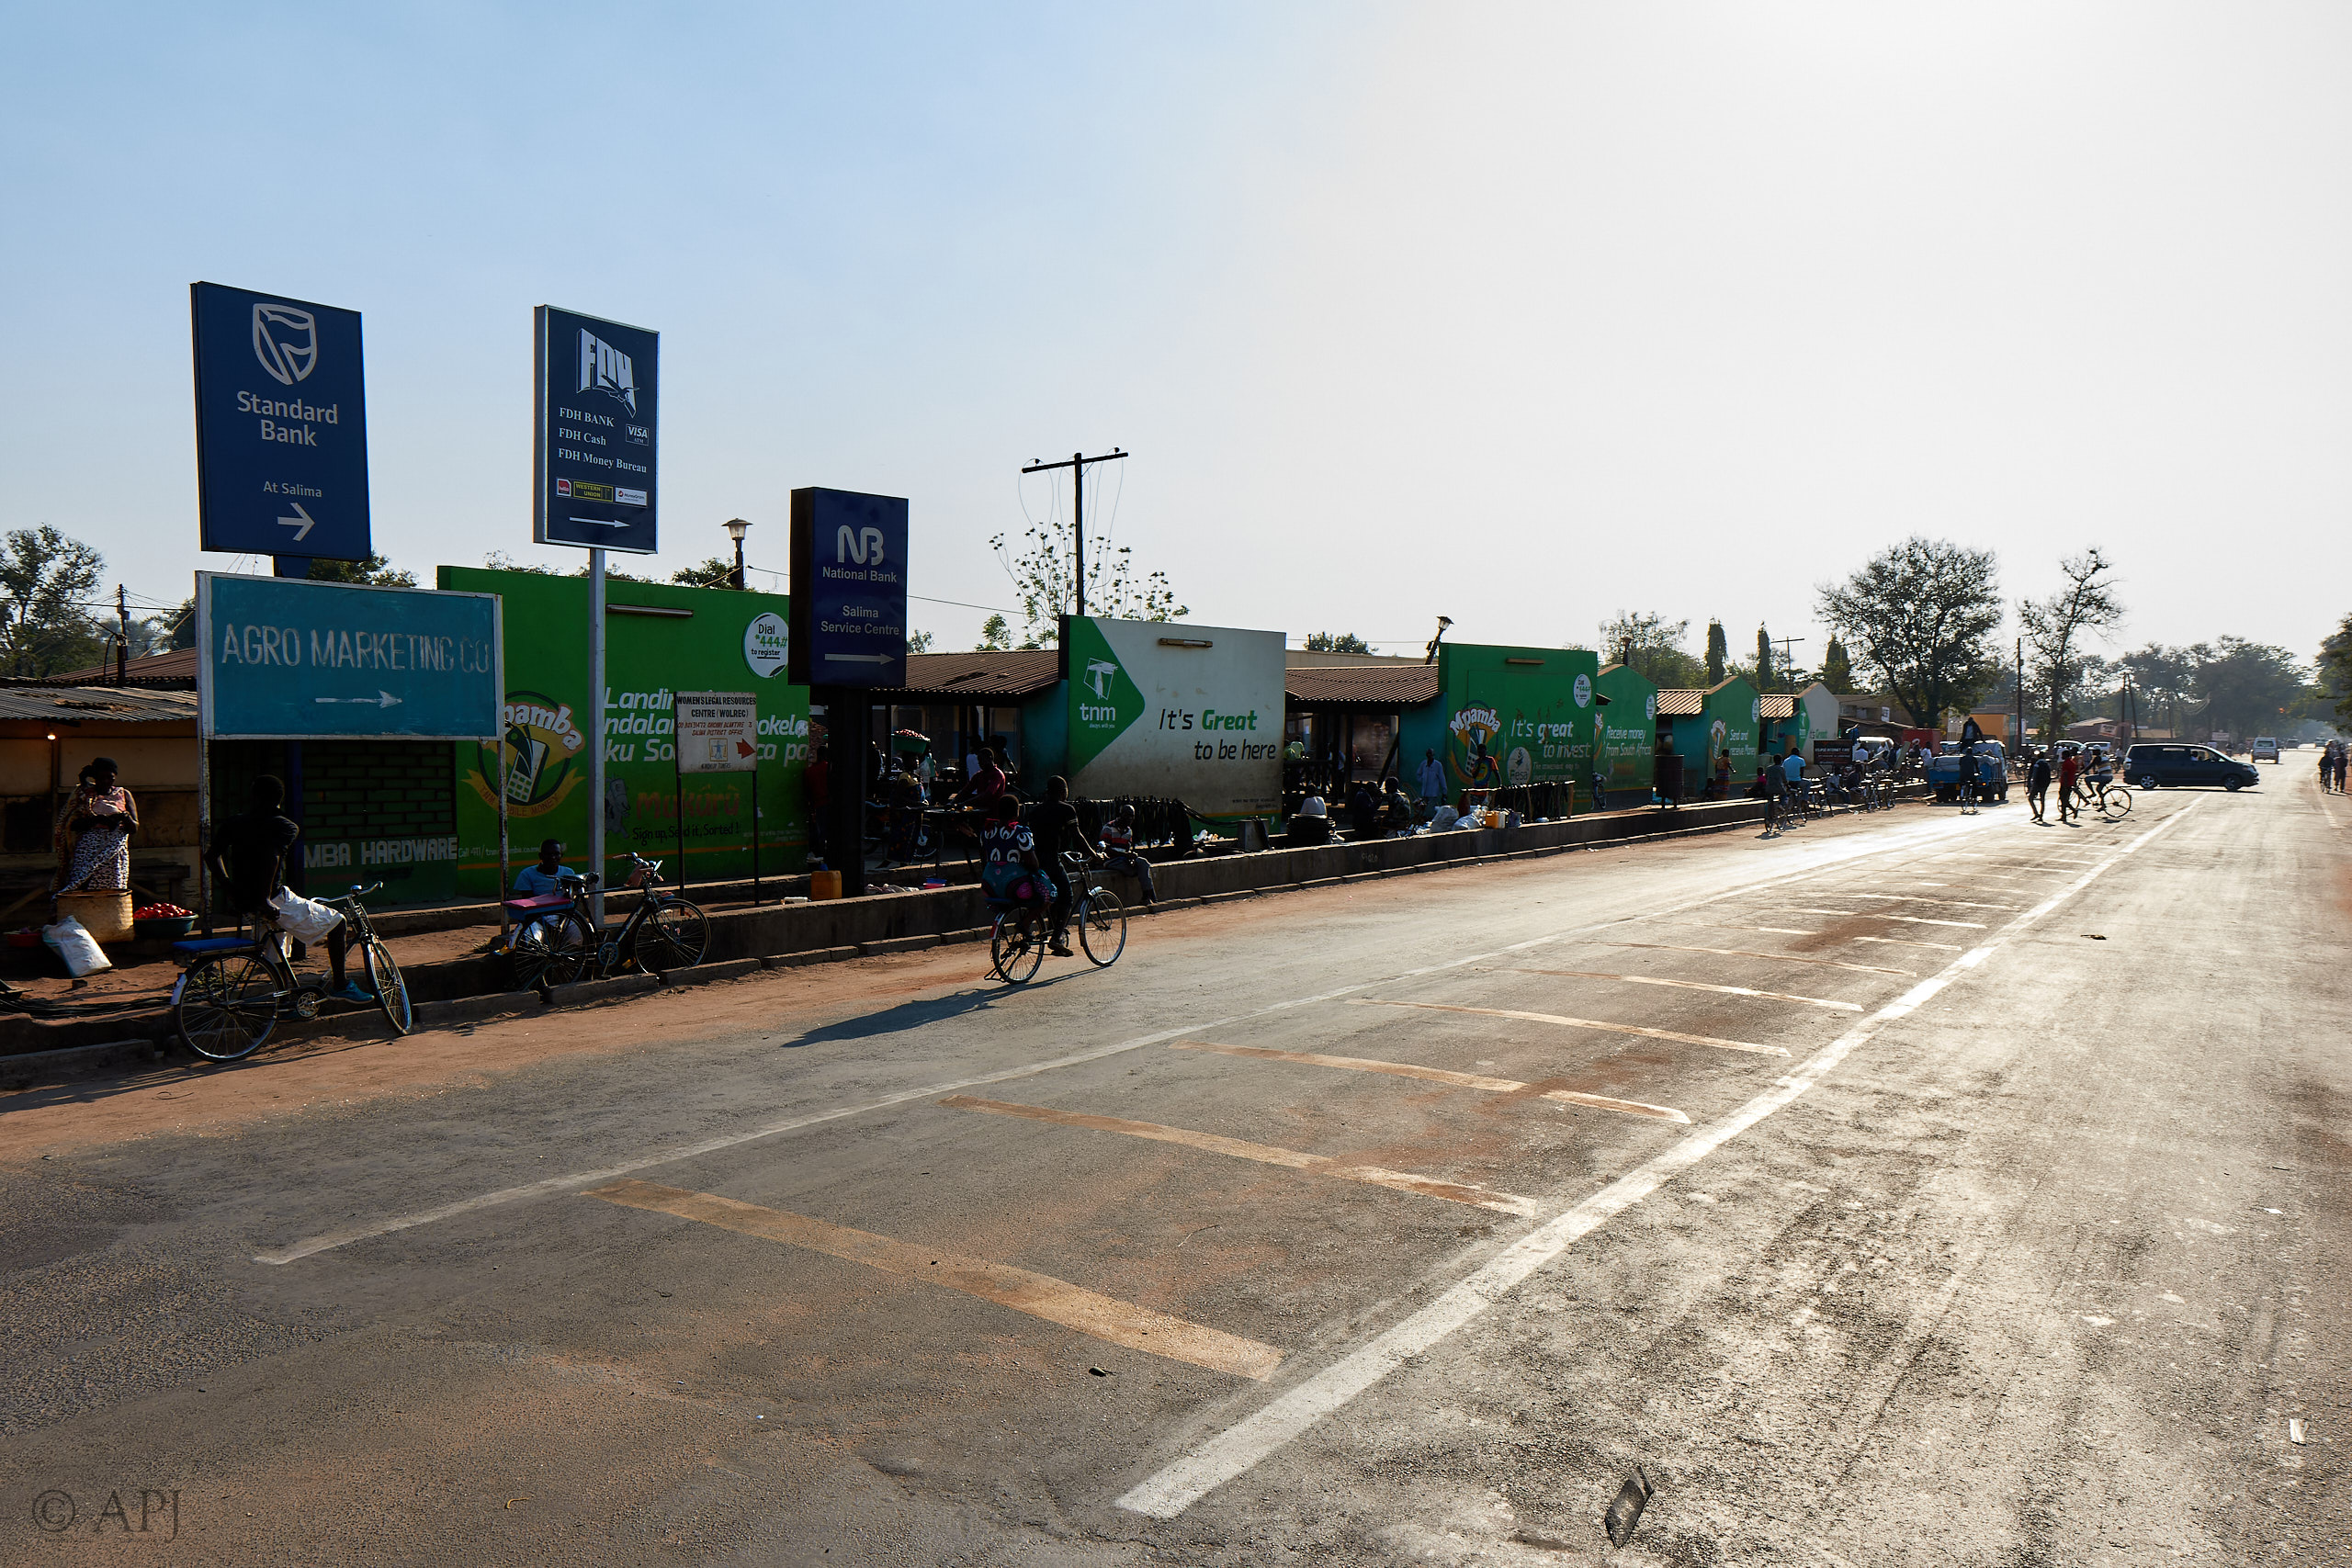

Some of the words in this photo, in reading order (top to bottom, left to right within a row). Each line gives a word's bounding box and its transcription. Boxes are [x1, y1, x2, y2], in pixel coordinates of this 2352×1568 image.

[236, 390, 338, 424] Standard
[560, 407, 582, 422] FDH
[584, 412, 615, 427] BANK
[261, 419, 317, 446] Bank
[559, 427, 581, 442] FDH
[583, 432, 606, 446] Cash
[628, 426, 648, 439] VISA
[559, 447, 581, 461] FDH
[583, 452, 614, 468] Money
[616, 458, 647, 473] Bureau
[264, 481, 277, 493] At
[281, 482, 322, 498] Salima
[838, 525, 884, 566] NB
[822, 567, 867, 581] National
[870, 570, 897, 582] Bank
[842, 605, 879, 618] Salima
[758, 624, 775, 635] Dial
[820, 621, 862, 634] Service
[865, 624, 899, 636] Centre
[221, 624, 300, 667] AGRO
[311, 628, 455, 671] MARKETING
[459, 636, 490, 673] CO
[758, 649, 780, 658] register
[705, 696, 722, 705] LEGAL
[723, 696, 756, 705] RESOURCES
[691, 709, 715, 717] CENTRE
[717, 709, 749, 717] (WOLREC)
[1080, 703, 1116, 721] tnm
[1159, 709, 1193, 730] It's
[1202, 709, 1258, 730] Great
[1449, 708, 1501, 736] Mpamba
[1510, 718, 1533, 737] It's
[1538, 721, 1574, 744] great
[605, 739, 635, 761] ku
[1194, 740, 1213, 760] to
[1218, 739, 1237, 760] be
[1241, 739, 1276, 760] here
[1544, 740, 1555, 758] to
[1556, 741, 1591, 758] invest
[505, 805, 528, 817] OBILE
[529, 795, 560, 816] MONEY
[632, 827, 653, 846] Sign
[360, 837, 458, 866] HARDWARE
